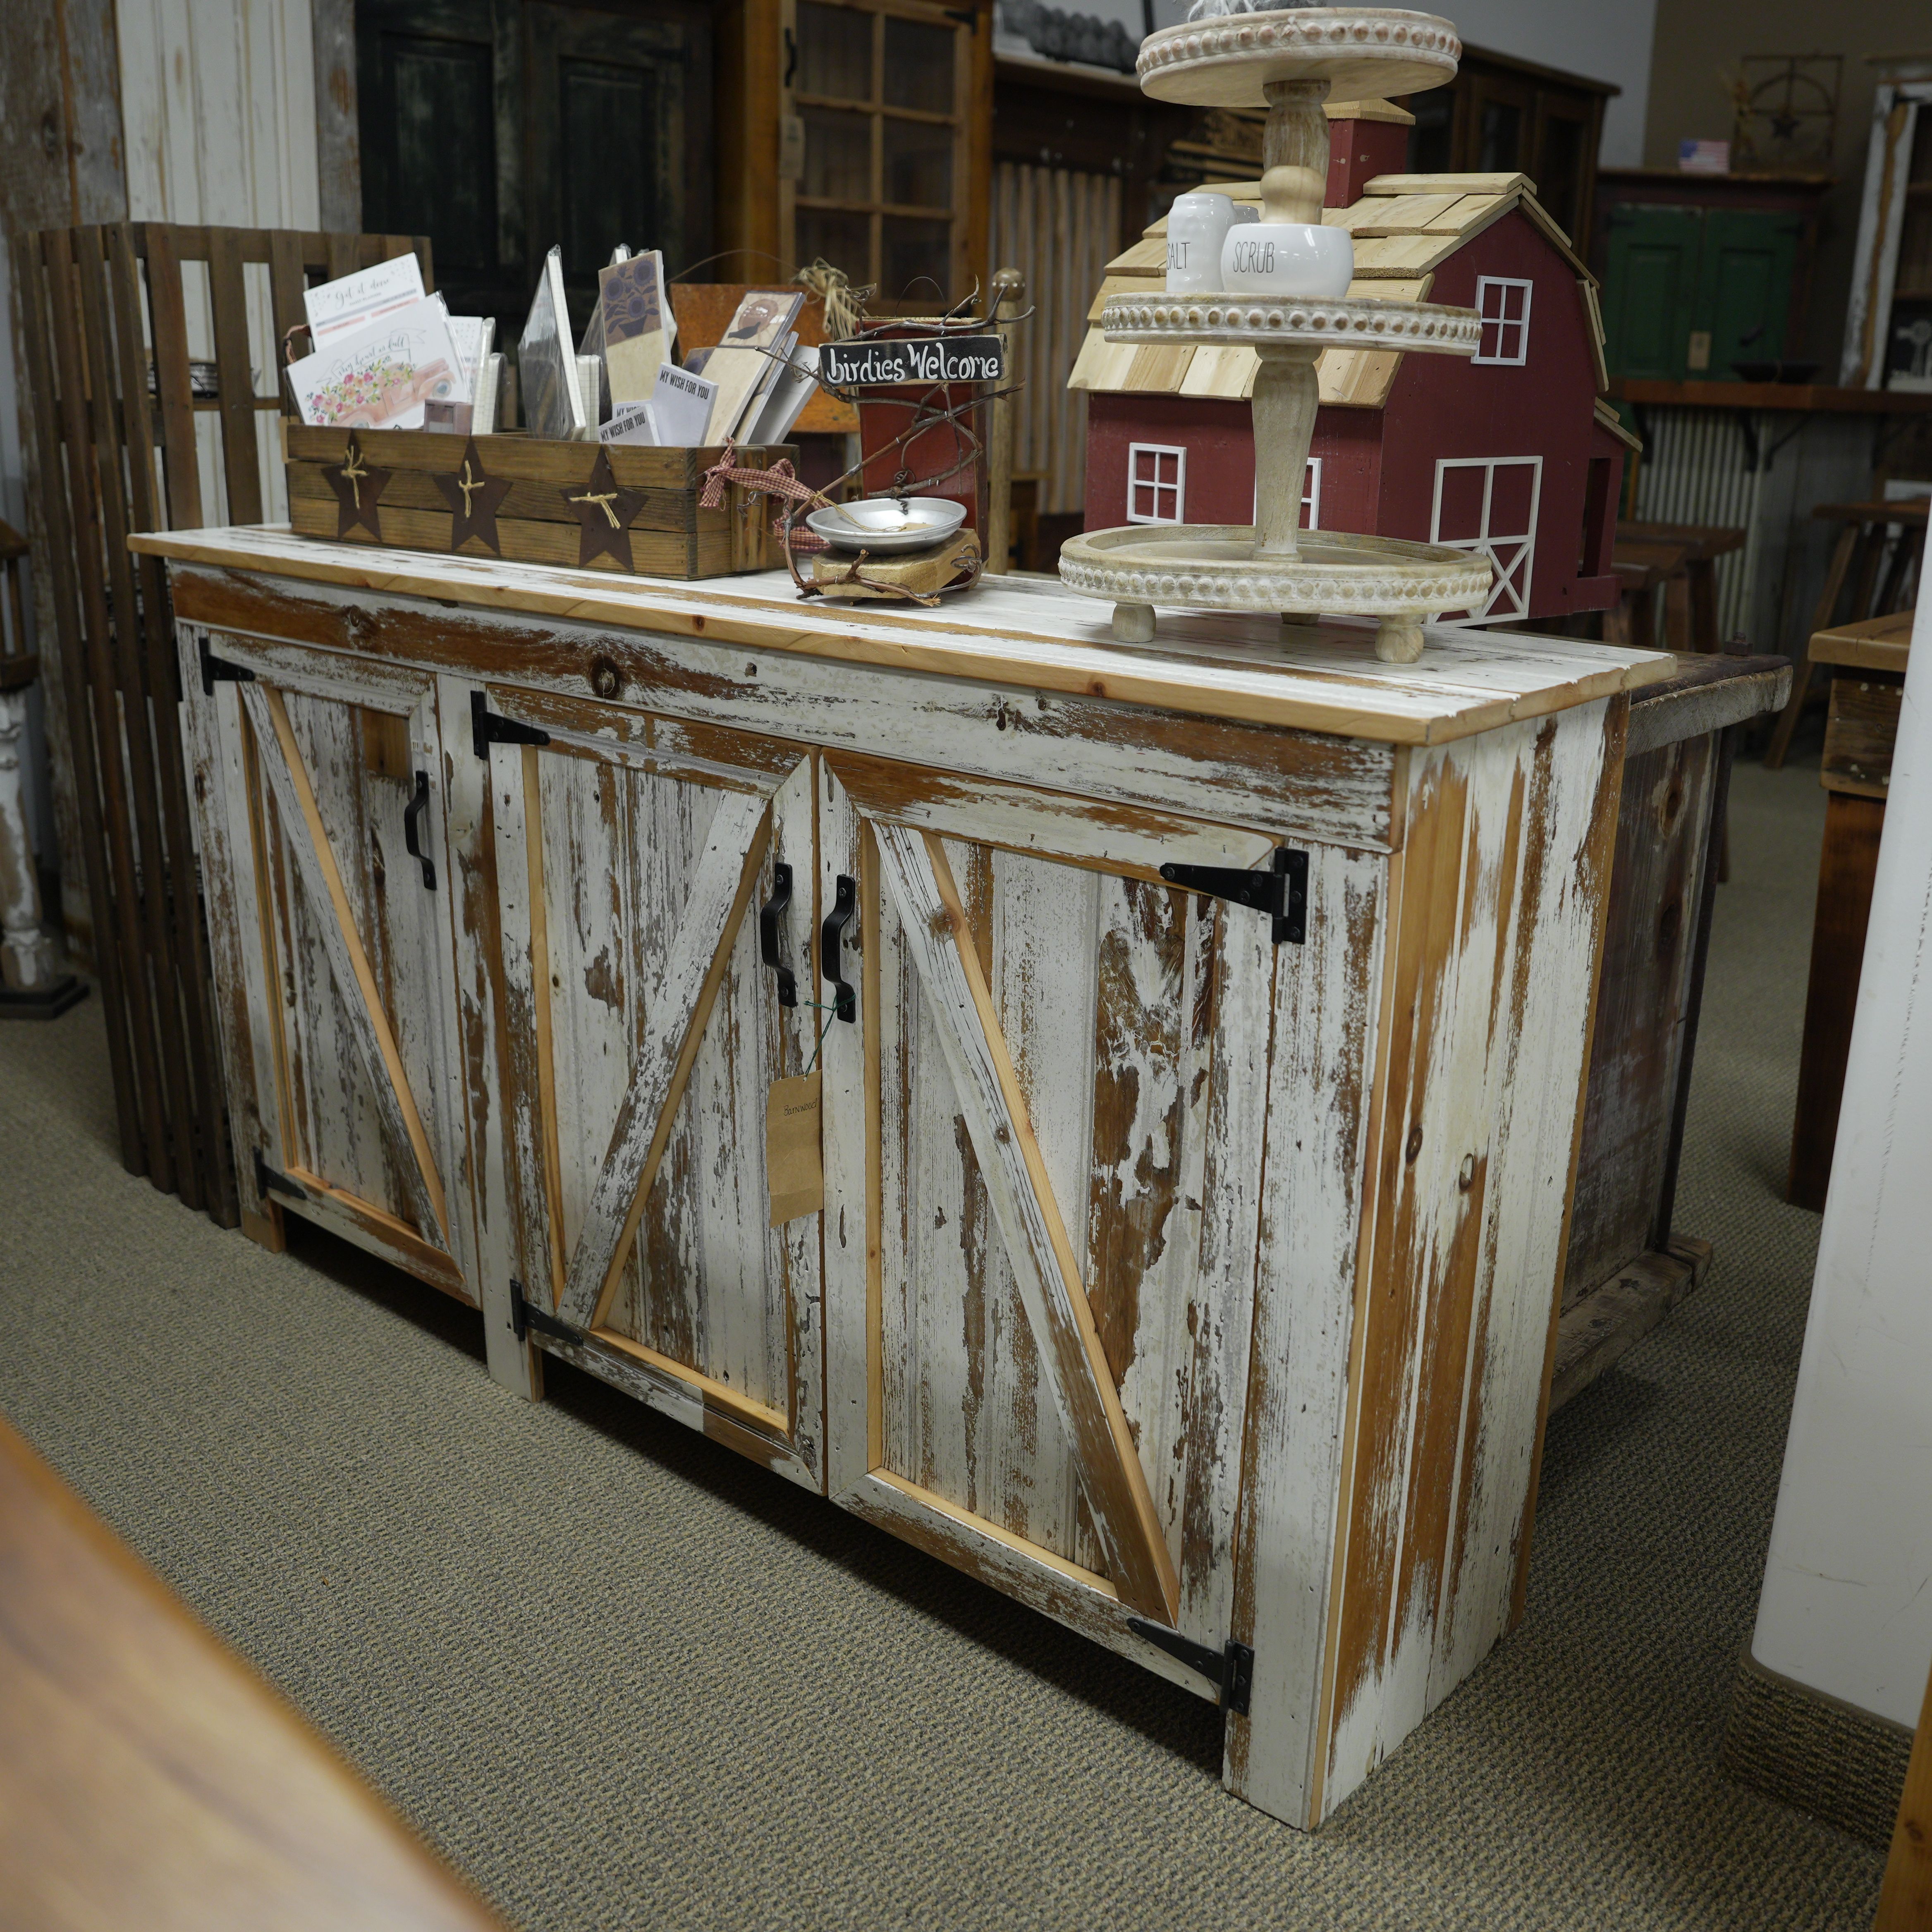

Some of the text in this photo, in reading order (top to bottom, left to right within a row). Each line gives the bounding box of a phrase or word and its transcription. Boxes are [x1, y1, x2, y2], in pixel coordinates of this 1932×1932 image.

[1167, 242, 1191, 270] SALT
[1233, 242, 1274, 273] SCRUB
[827, 342, 999, 384] birdies Welcome
[660, 369, 710, 399] MY WISH FOR YOU
[601, 412, 645, 442] MY WISH FOR YOU
[617, 407, 625, 418] MY
